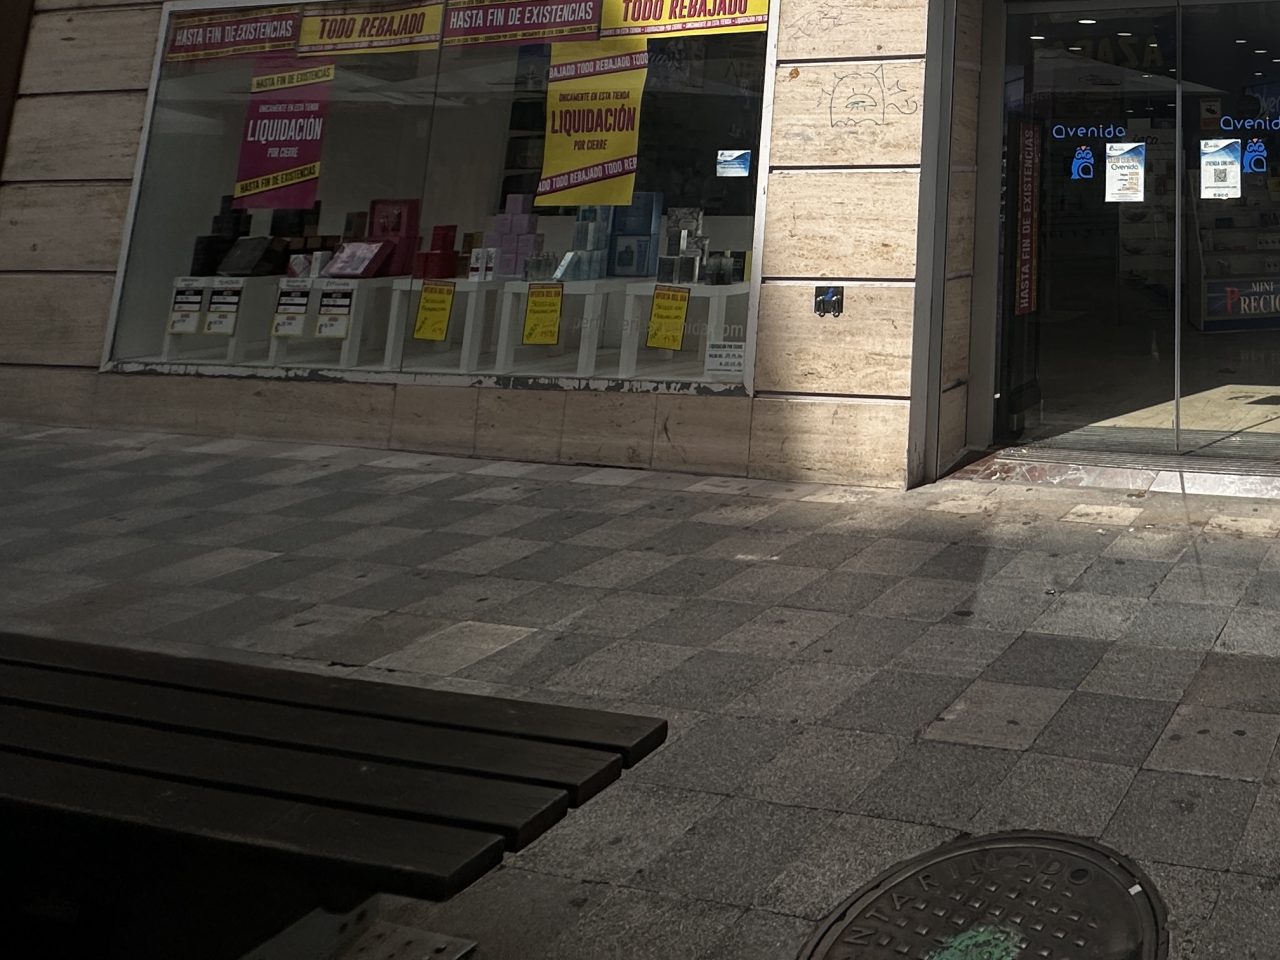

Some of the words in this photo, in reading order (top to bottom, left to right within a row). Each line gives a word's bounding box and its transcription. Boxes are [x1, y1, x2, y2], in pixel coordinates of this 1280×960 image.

[319, 17, 357, 40] TODO
[358, 12, 426, 38] REBAJADO
[450, 10, 483, 28] HASTA
[487, 9, 504, 27] FIN
[508, 7, 522, 25] DE
[524, 2, 593, 24] EXISTENCIAS
[175, 28, 203, 46] HASTA
[206, 26, 222, 43] FIN
[224, 25, 238, 42] DE
[236, 20, 293, 41] EXISTENCIAS
[577, 62, 594, 74] TODO
[595, 56, 630, 72] REBAJADO
[632, 53, 649, 65] TODO
[247, 115, 323, 144] LIQUIDACIÓN
[551, 104, 636, 137] LIQUIDACIÓN
[574, 140, 585, 151] POR
[586, 139, 608, 150] CIERRE
[552, 176, 568, 189] TODO
[570, 166, 602, 185] REBAJADO
[604, 161, 621, 175] TODO
[1023, 129, 1034, 213] EXISTENCIAS
[1023, 217, 1031, 234] DE
[1022, 239, 1031, 259] FIN
[1020, 264, 1030, 308] HASTA
[1251, 281, 1274, 292] MINI
